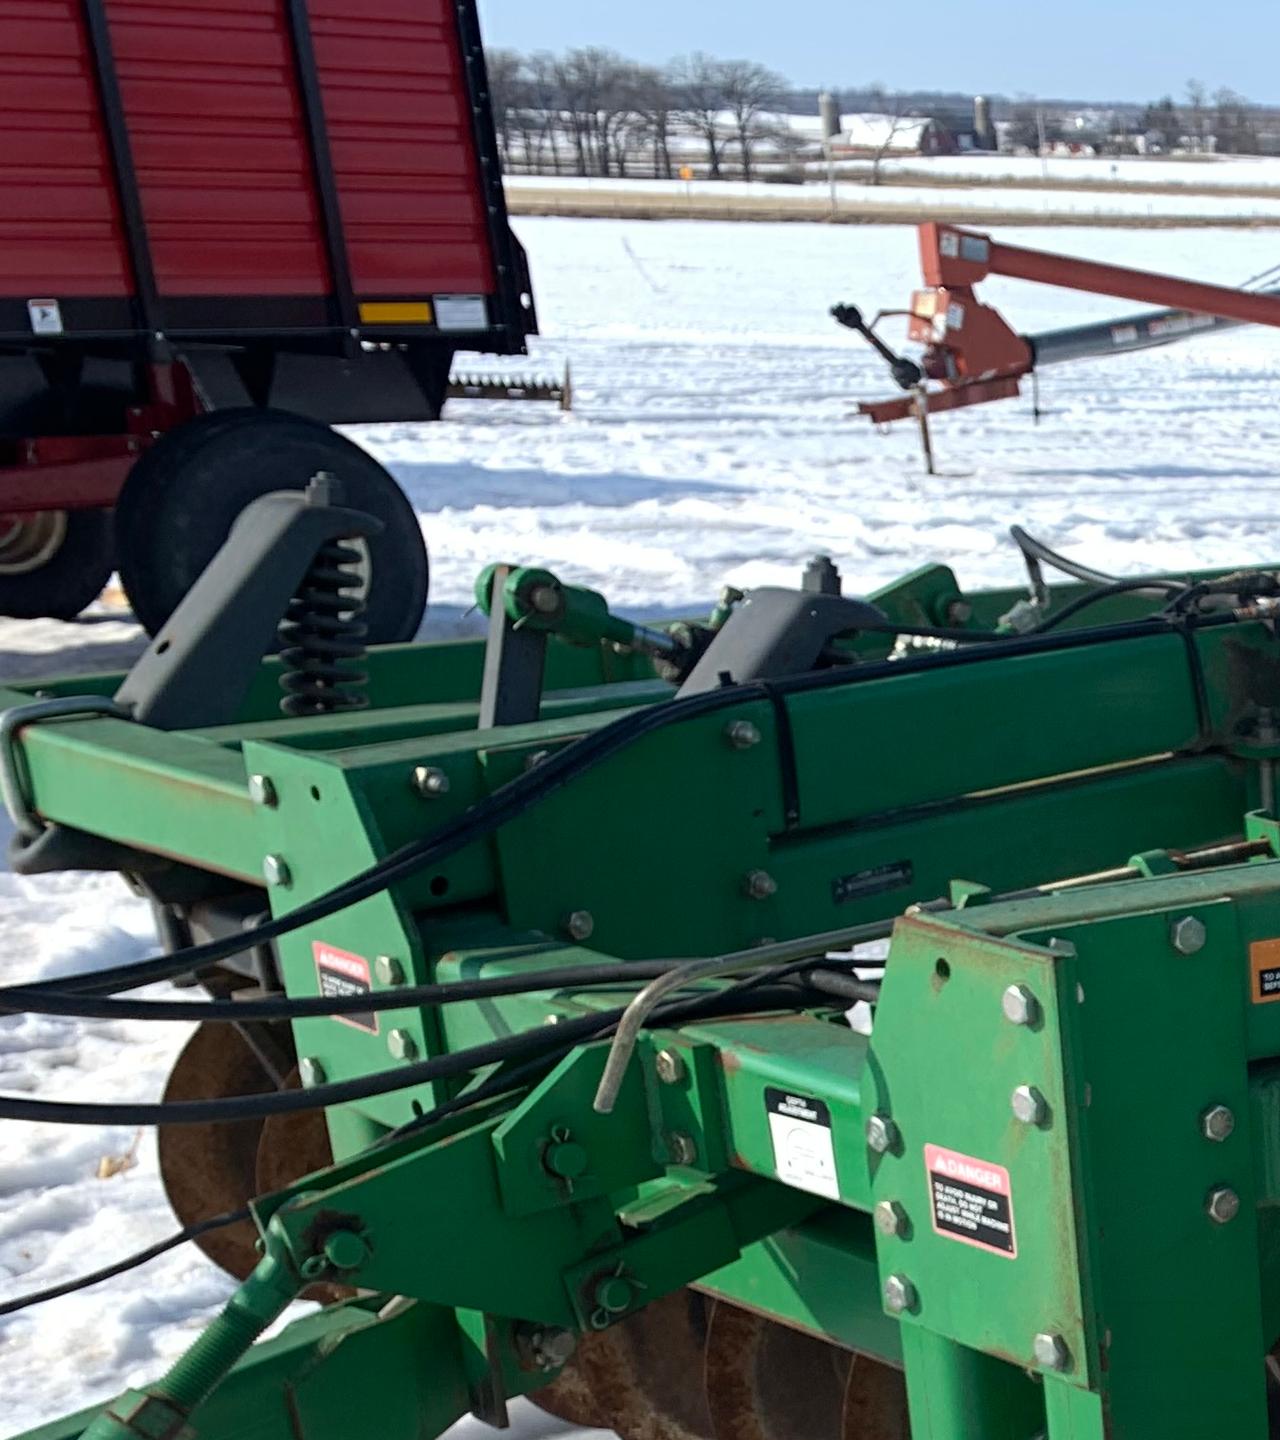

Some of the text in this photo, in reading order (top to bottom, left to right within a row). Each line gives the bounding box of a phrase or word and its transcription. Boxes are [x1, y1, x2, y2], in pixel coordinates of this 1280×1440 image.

[1263, 972, 1275, 981] TO
[947, 1159, 1002, 1187] DANGER
[934, 1181, 944, 1192] TO
[944, 1185, 964, 1199] AVOID
